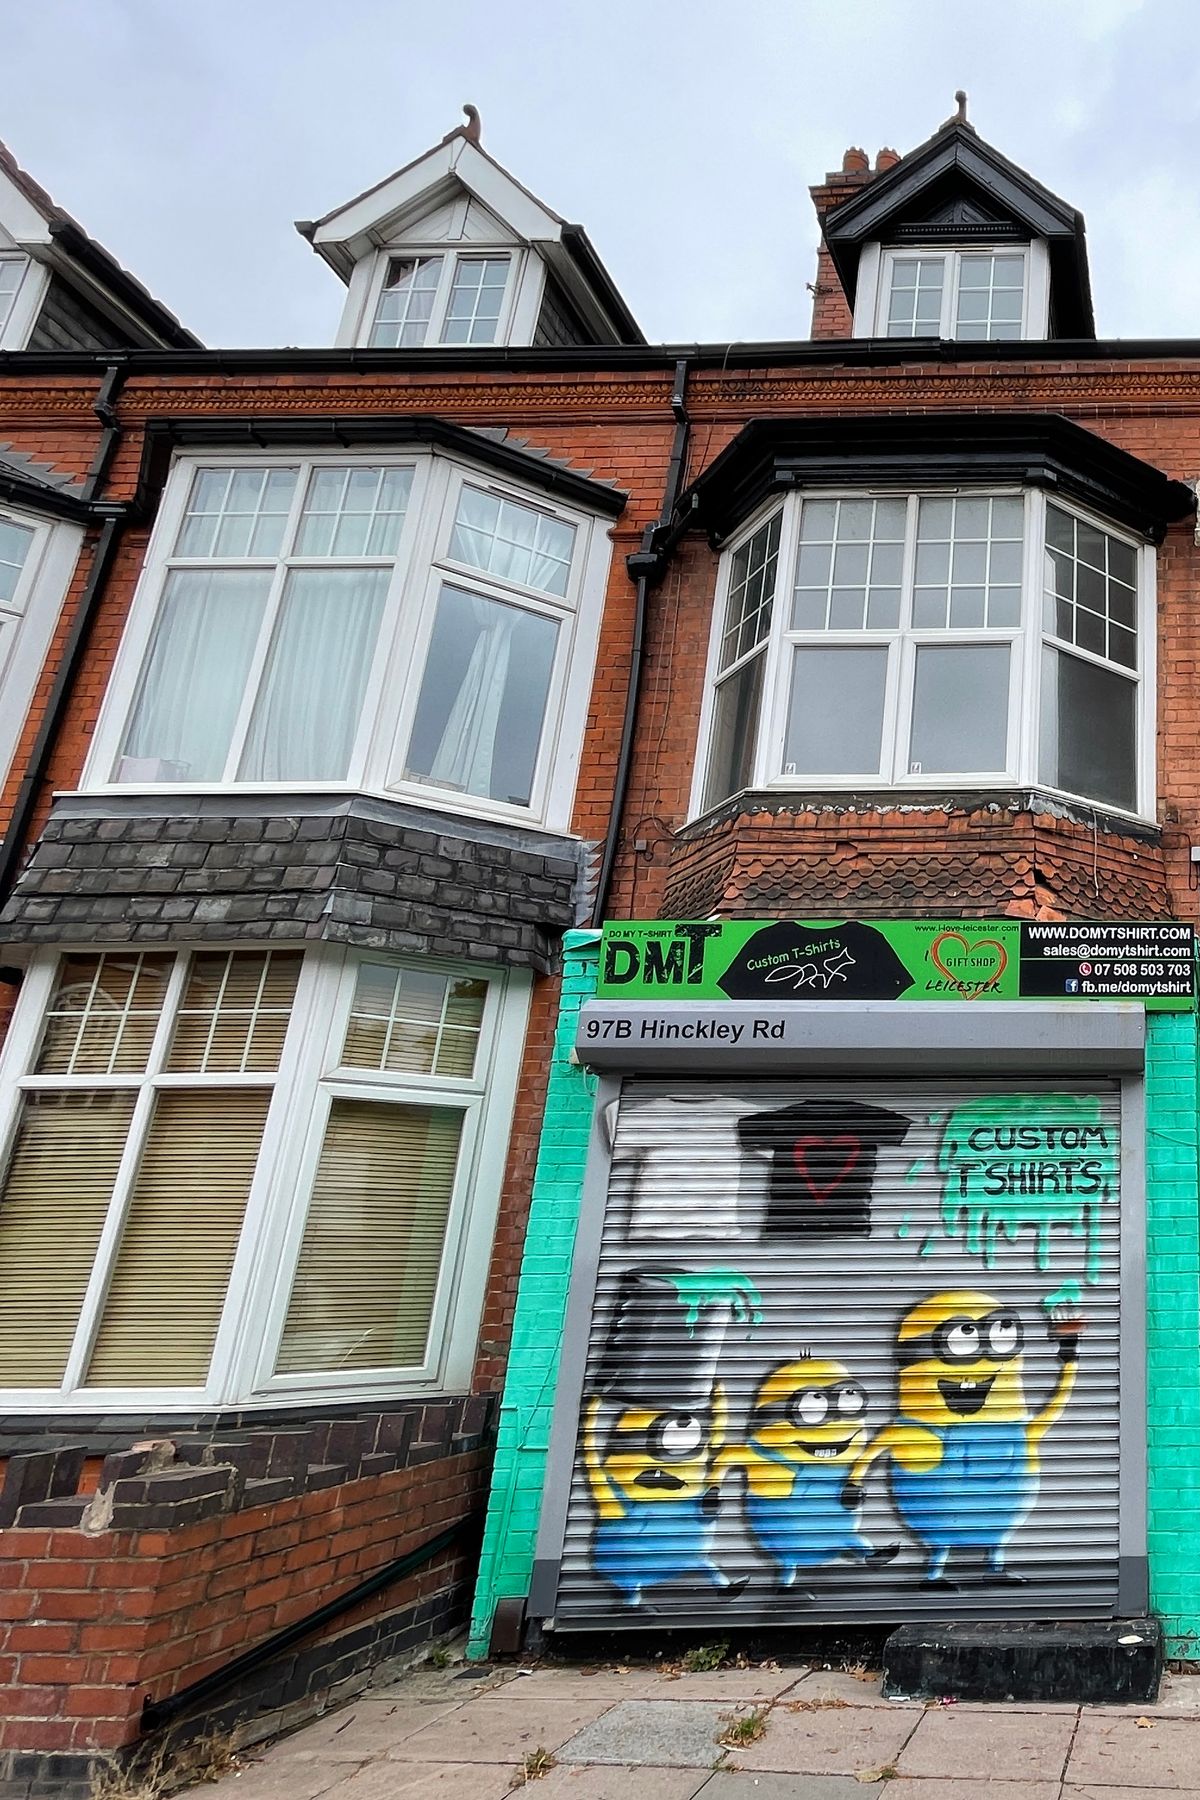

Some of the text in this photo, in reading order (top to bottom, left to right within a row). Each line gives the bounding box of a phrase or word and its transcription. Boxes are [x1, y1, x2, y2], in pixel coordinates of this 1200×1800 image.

[609, 930, 673, 938] DO MY T-SHIRT
[1028, 927, 1191, 939] WWW.DOMYTSHIRT.COM
[603, 924, 723, 984] DMT
[747, 939, 841, 971] Custom T-Shirts
[1043, 944, 1191, 959] sales@domytshirt.com
[946, 957, 996, 967] GIFT SHOP
[1094, 964, 1191, 976] 07 508 503 703
[925, 980, 1004, 994] LEICESTER
[1081, 981, 1192, 996] fb.me/domytshirt
[586, 1020, 786, 1044] 97B Hinckley Rd
[967, 1126, 1109, 1152] CUSTOM
